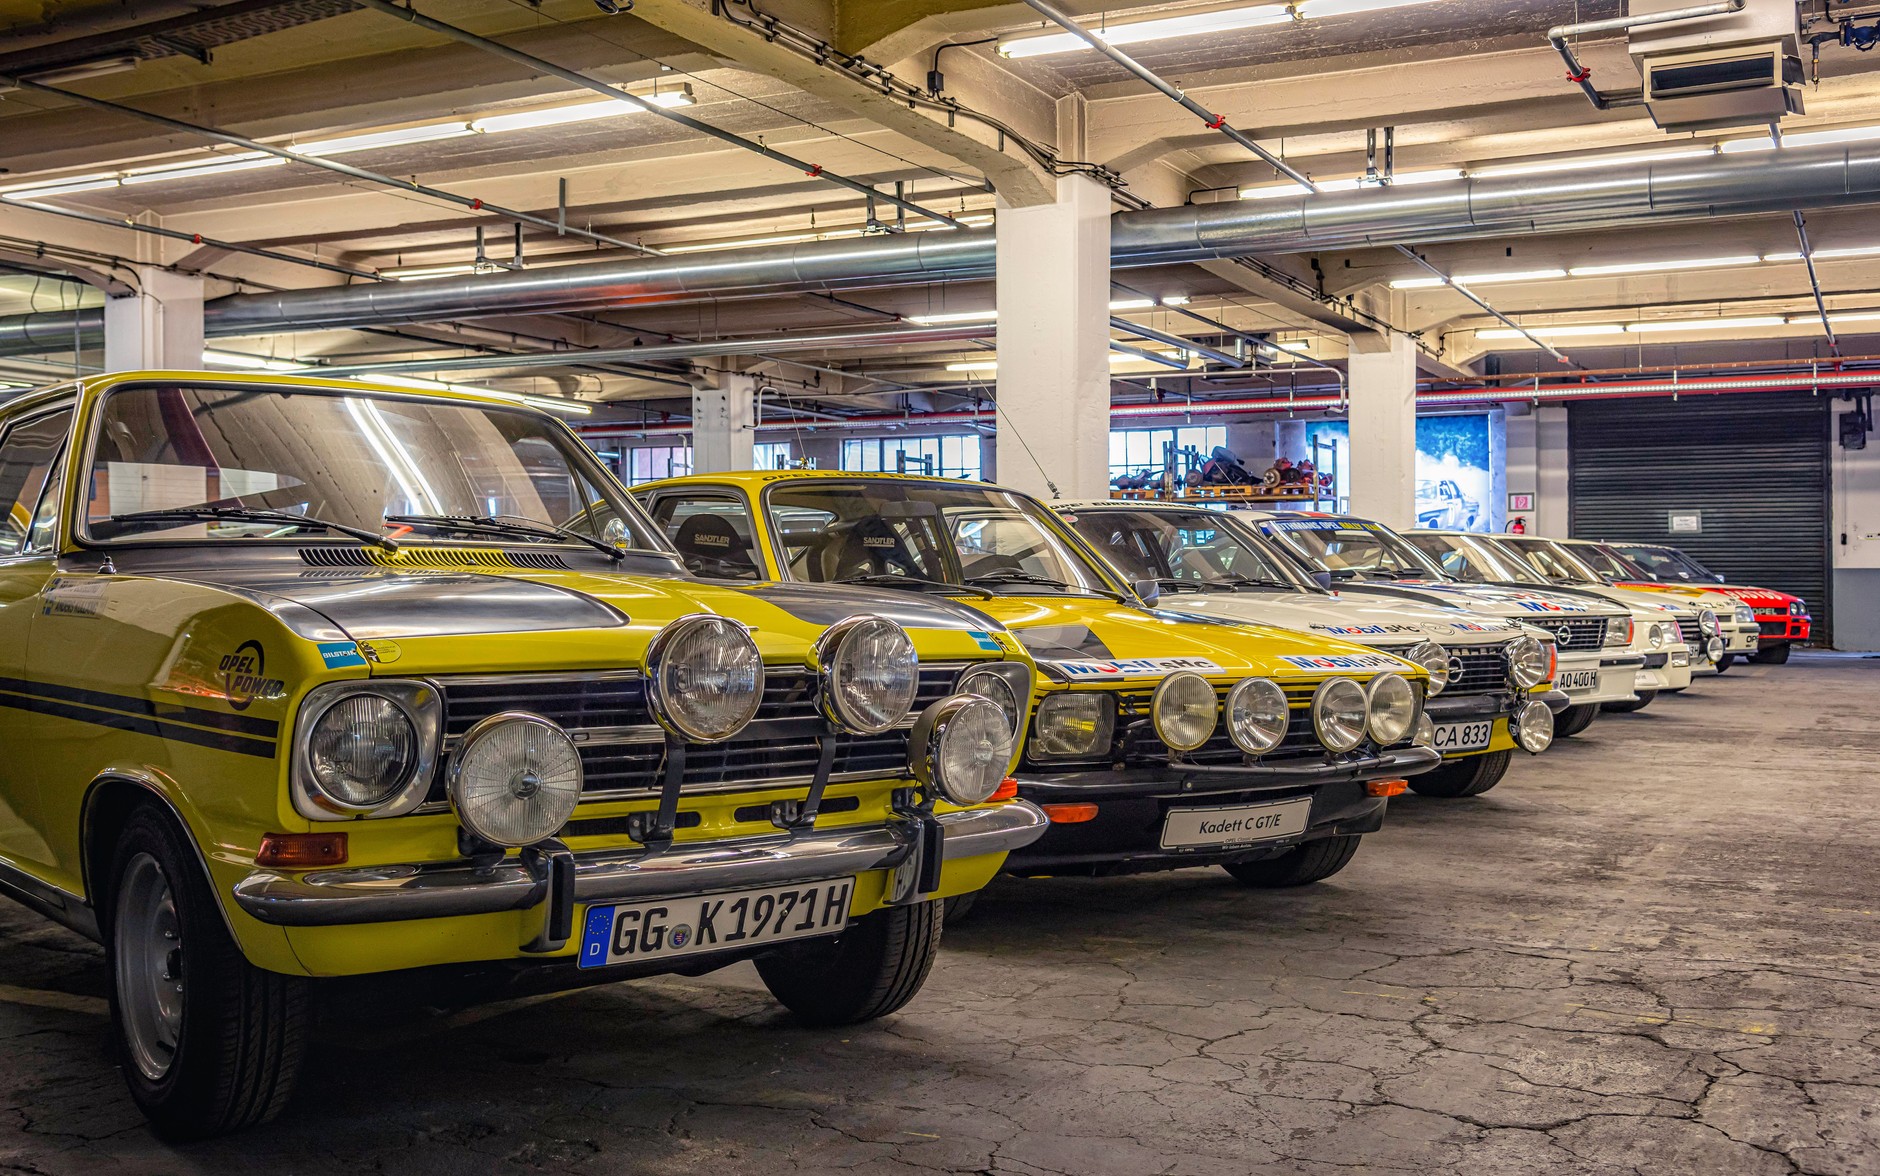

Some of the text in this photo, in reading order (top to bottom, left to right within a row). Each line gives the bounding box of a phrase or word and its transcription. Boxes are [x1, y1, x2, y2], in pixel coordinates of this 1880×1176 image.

[762, 473, 817, 481] OPEL
[694, 533, 730, 545] SANDTLER
[863, 536, 895, 545] SANDTLER
[1753, 607, 1778, 616] OPEL
[1325, 624, 1387, 636] Mobil
[219, 654, 255, 674] OPEL
[1059, 659, 1162, 675] Mobil
[1283, 656, 1366, 669] Mobil
[231, 675, 285, 698] POWER
[1461, 723, 1489, 746] 833
[1199, 813, 1283, 835] Kadett C GT/E
[611, 906, 669, 957] GG
[589, 942, 600, 957] D
